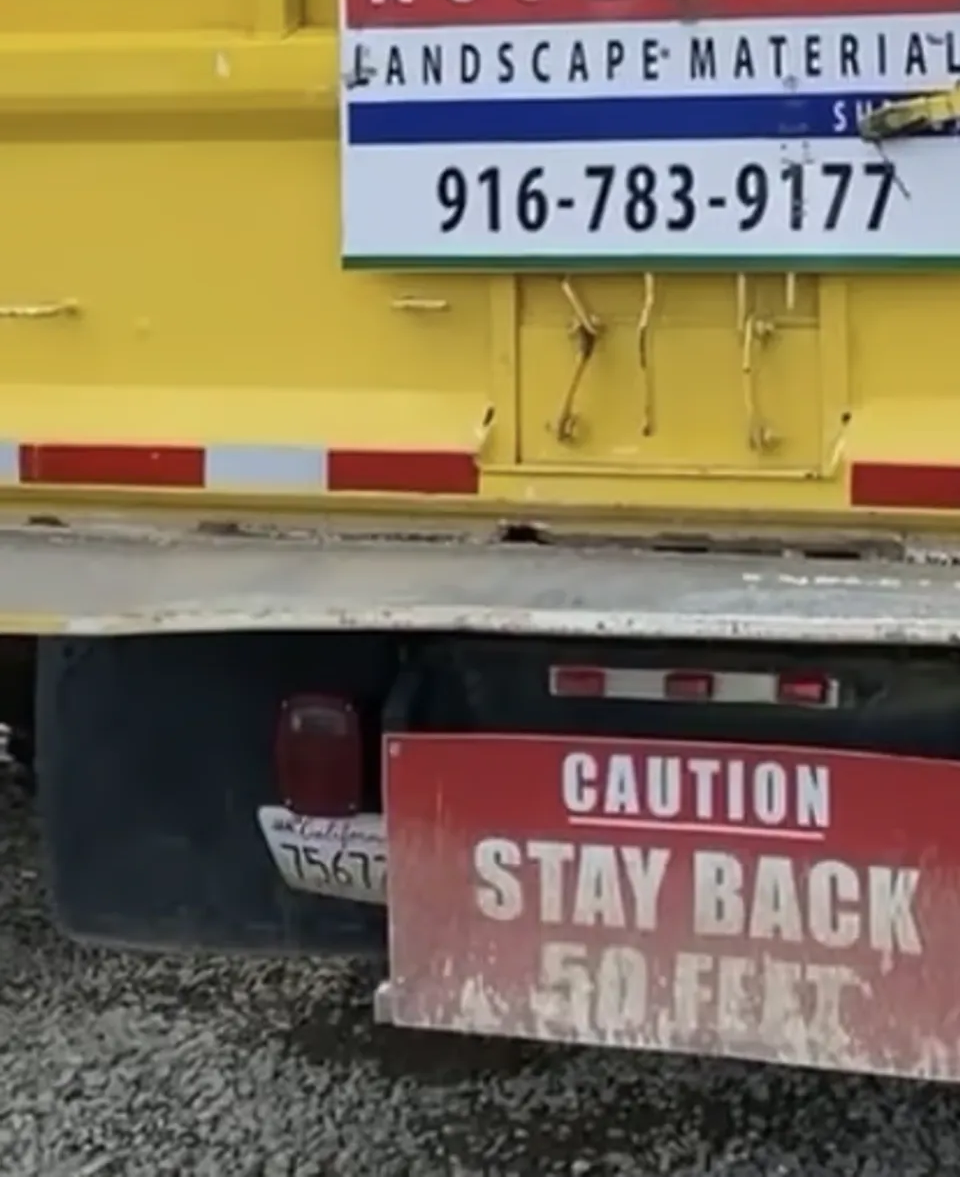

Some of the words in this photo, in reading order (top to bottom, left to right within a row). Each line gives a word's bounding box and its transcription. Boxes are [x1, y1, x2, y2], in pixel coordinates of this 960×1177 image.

[353, 38, 661, 87] LANDSCAPE
[437, 163, 896, 232] 916-783-9177
[561, 751, 831, 828] CAUTION
[298, 816, 388, 849] Californ
[473, 837, 672, 931] STAY
[692, 856, 922, 954] BACK
[535, 940, 648, 1029] 50
[670, 950, 862, 1043] FEET
